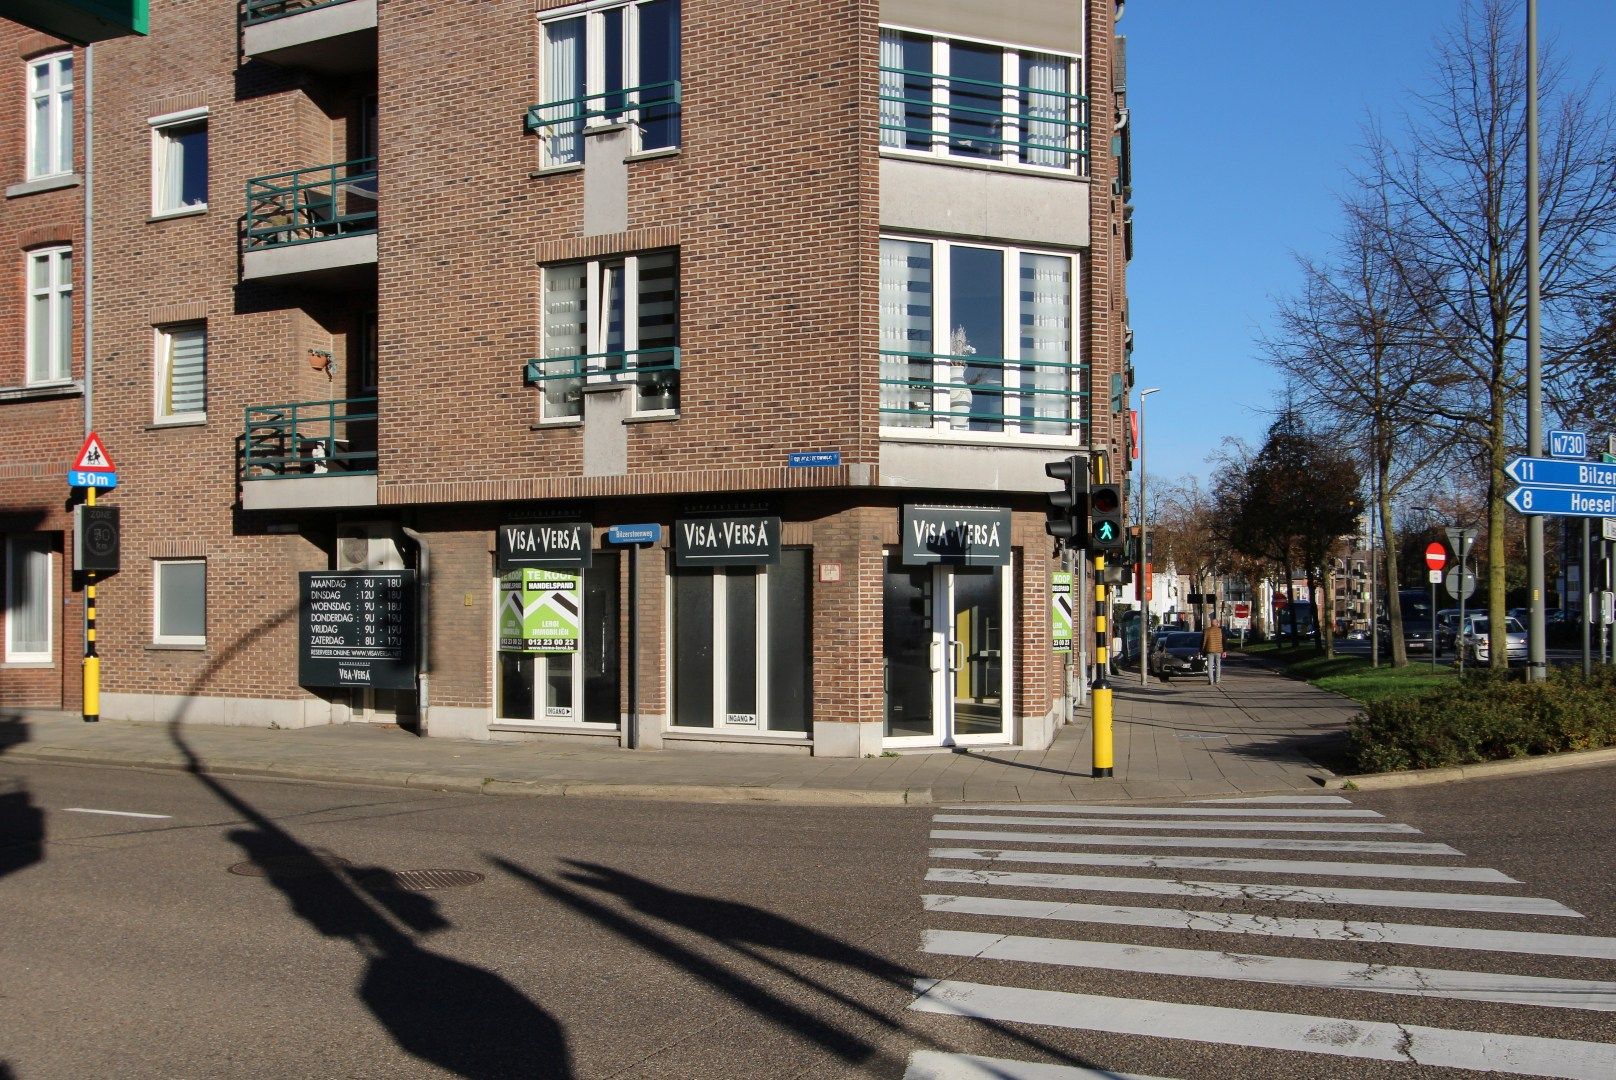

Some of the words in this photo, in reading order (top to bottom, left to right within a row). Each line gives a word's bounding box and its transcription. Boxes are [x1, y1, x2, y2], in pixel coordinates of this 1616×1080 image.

[1554, 436, 1582, 454] N730
[1522, 462, 1534, 480] 11
[78, 473, 108, 485] 50m
[1523, 490, 1532, 509] 8
[1571, 493, 1616, 512] Hoesel
[311, 579, 346, 588] MAANDAG
[365, 579, 374, 587] 9U
[387, 579, 401, 588] 18U
[311, 591, 340, 599] DINSDAG
[361, 591, 374, 599] 12U
[311, 602, 351, 611] WOENSDAG
[365, 602, 374, 610] 9U
[311, 614, 353, 622] DONDERDAG
[365, 614, 374, 622] 9U
[365, 625, 374, 633] 9U
[311, 636, 344, 644] ZATERDAG
[365, 637, 374, 645] 8U
